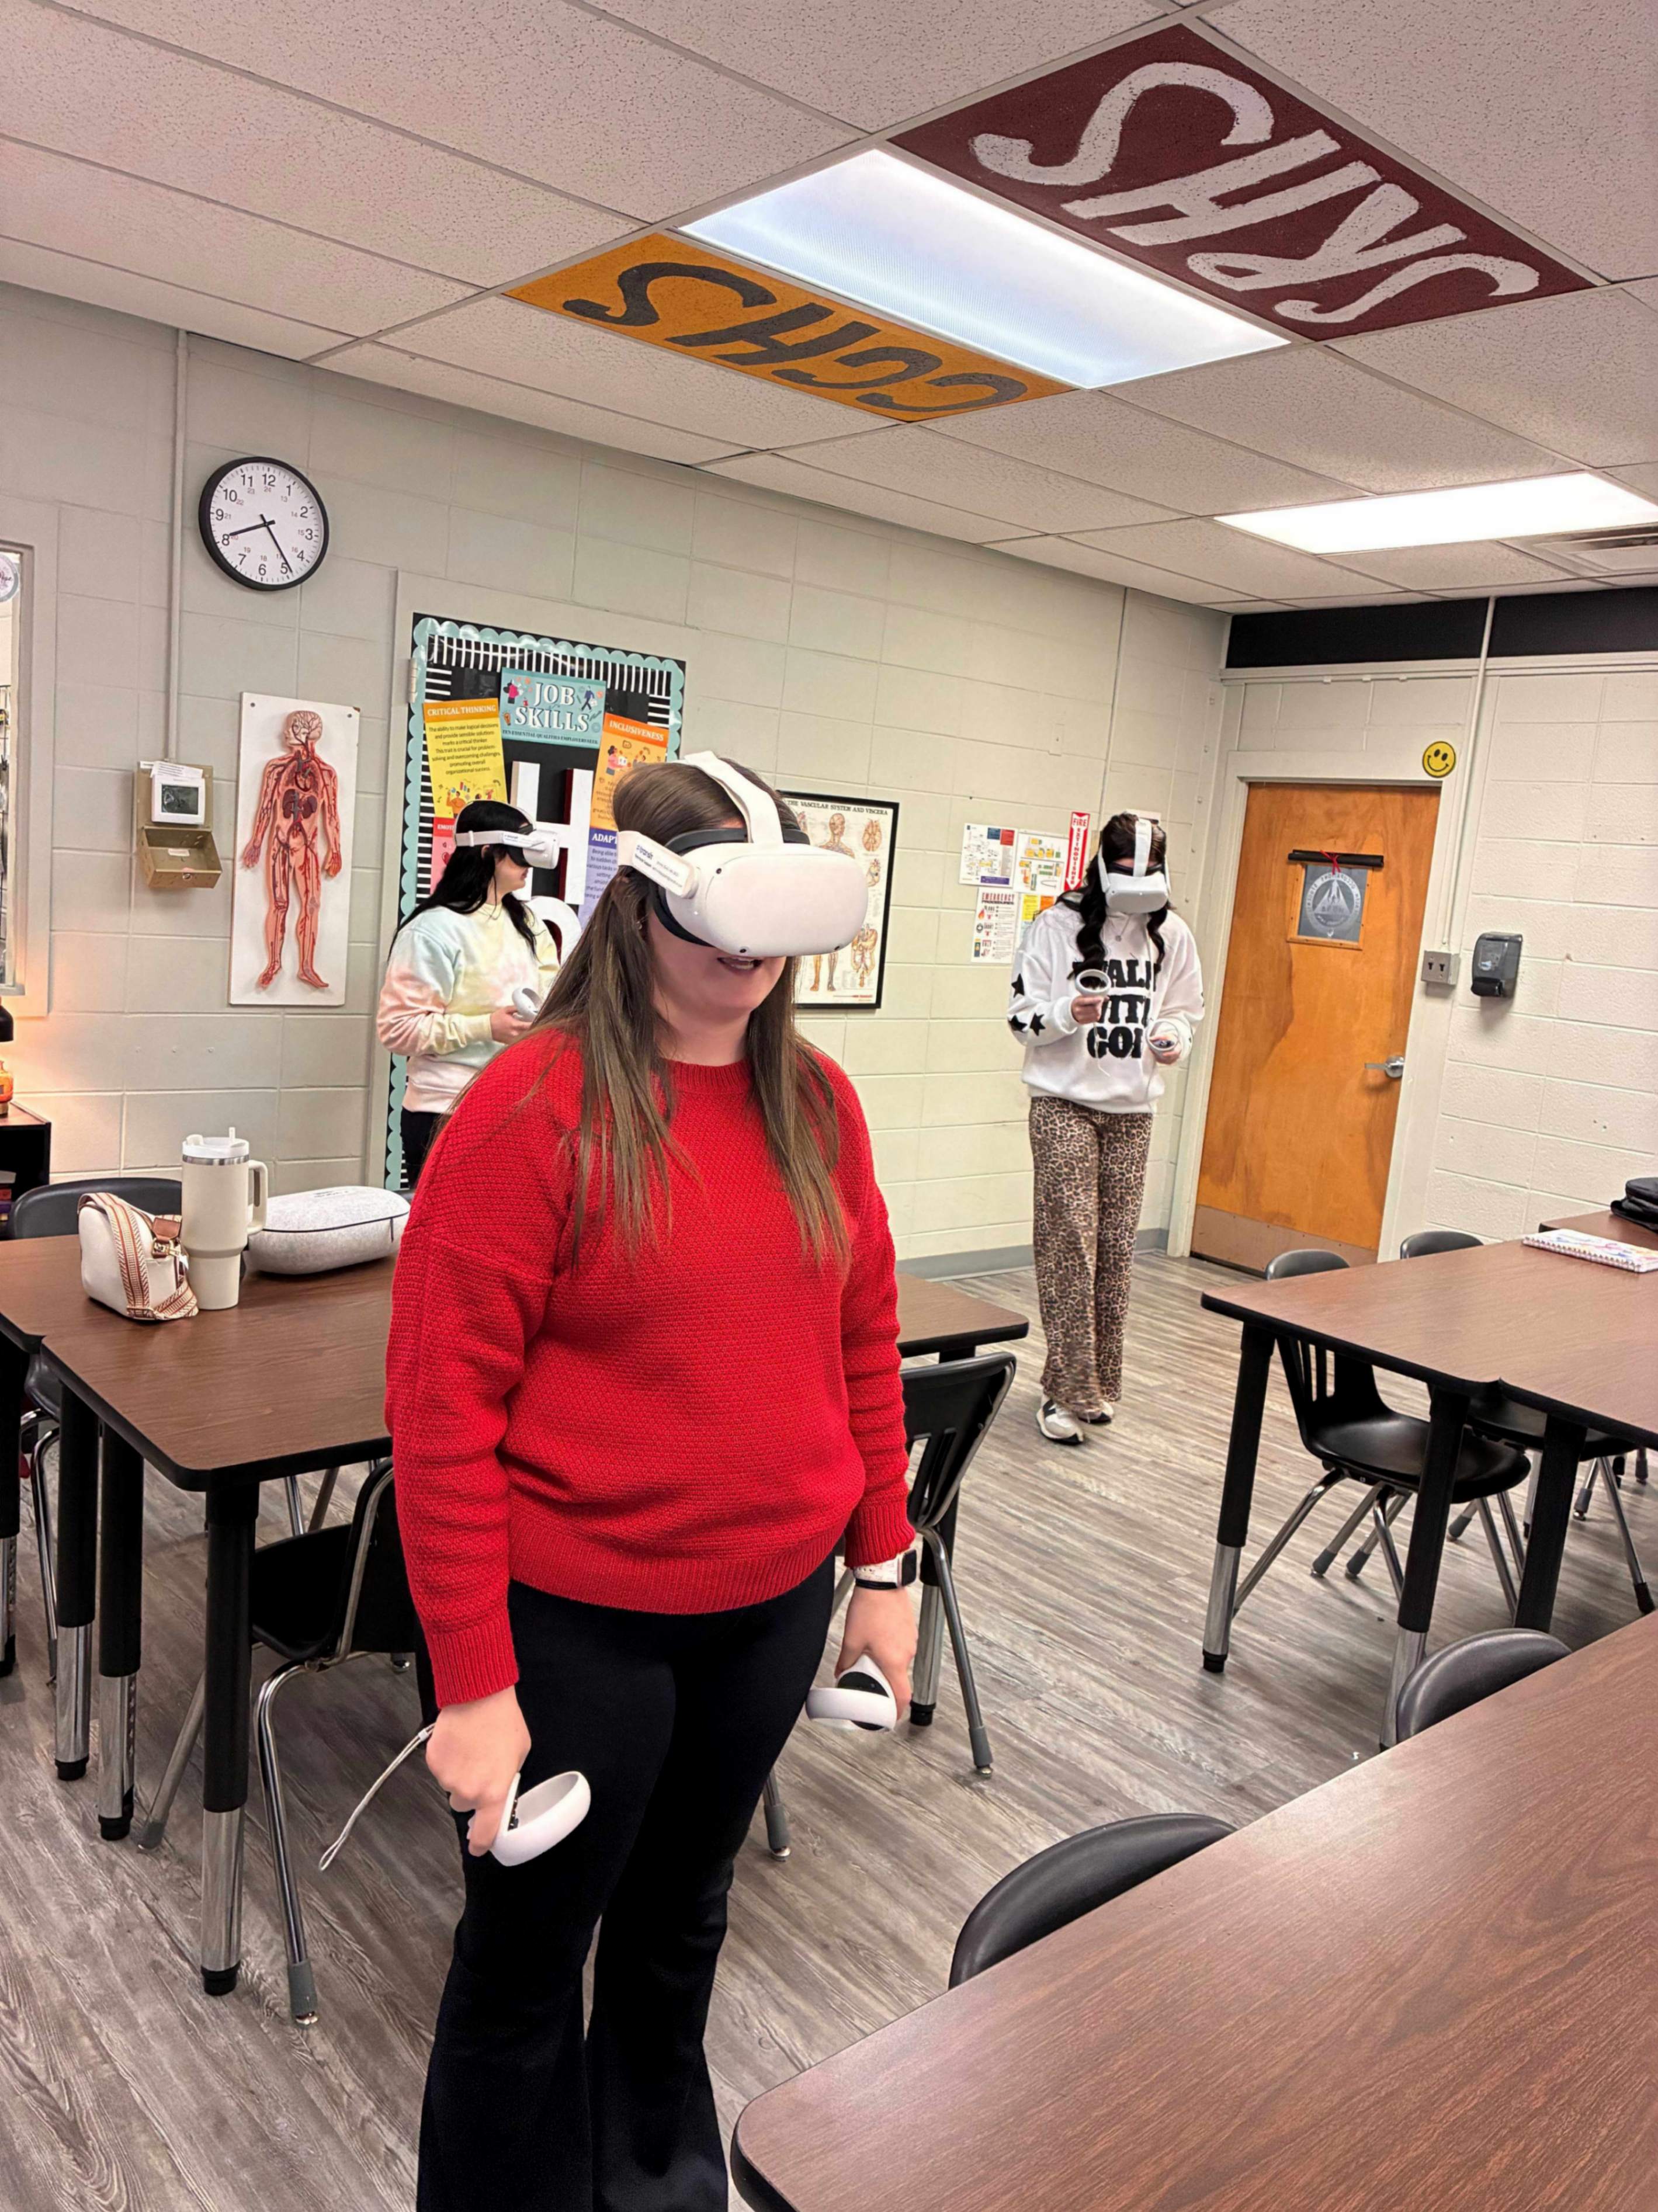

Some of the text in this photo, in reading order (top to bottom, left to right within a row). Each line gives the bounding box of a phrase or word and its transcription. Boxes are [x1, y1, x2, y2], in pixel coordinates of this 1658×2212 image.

[563, 261, 1028, 412] CCHS
[241, 474, 253, 487] 11
[262, 474, 276, 487] 12
[223, 488, 237, 502] 10
[286, 485, 291, 496] 1
[216, 509, 224, 520] 9
[300, 506, 308, 518] 2
[221, 534, 230, 546] 8
[305, 528, 313, 540] 3
[238, 554, 246, 565] 7
[297, 550, 305, 561] 4
[258, 564, 266, 576] 6
[280, 562, 289, 574] 5
[533, 682, 575, 706] JOB
[427, 704, 497, 717] CRITICAL THINKING
[514, 706, 589, 732] SKILLS
[609, 720, 664, 742] INCLUSIVENESS
[1073, 818, 1087, 827] FIRE
